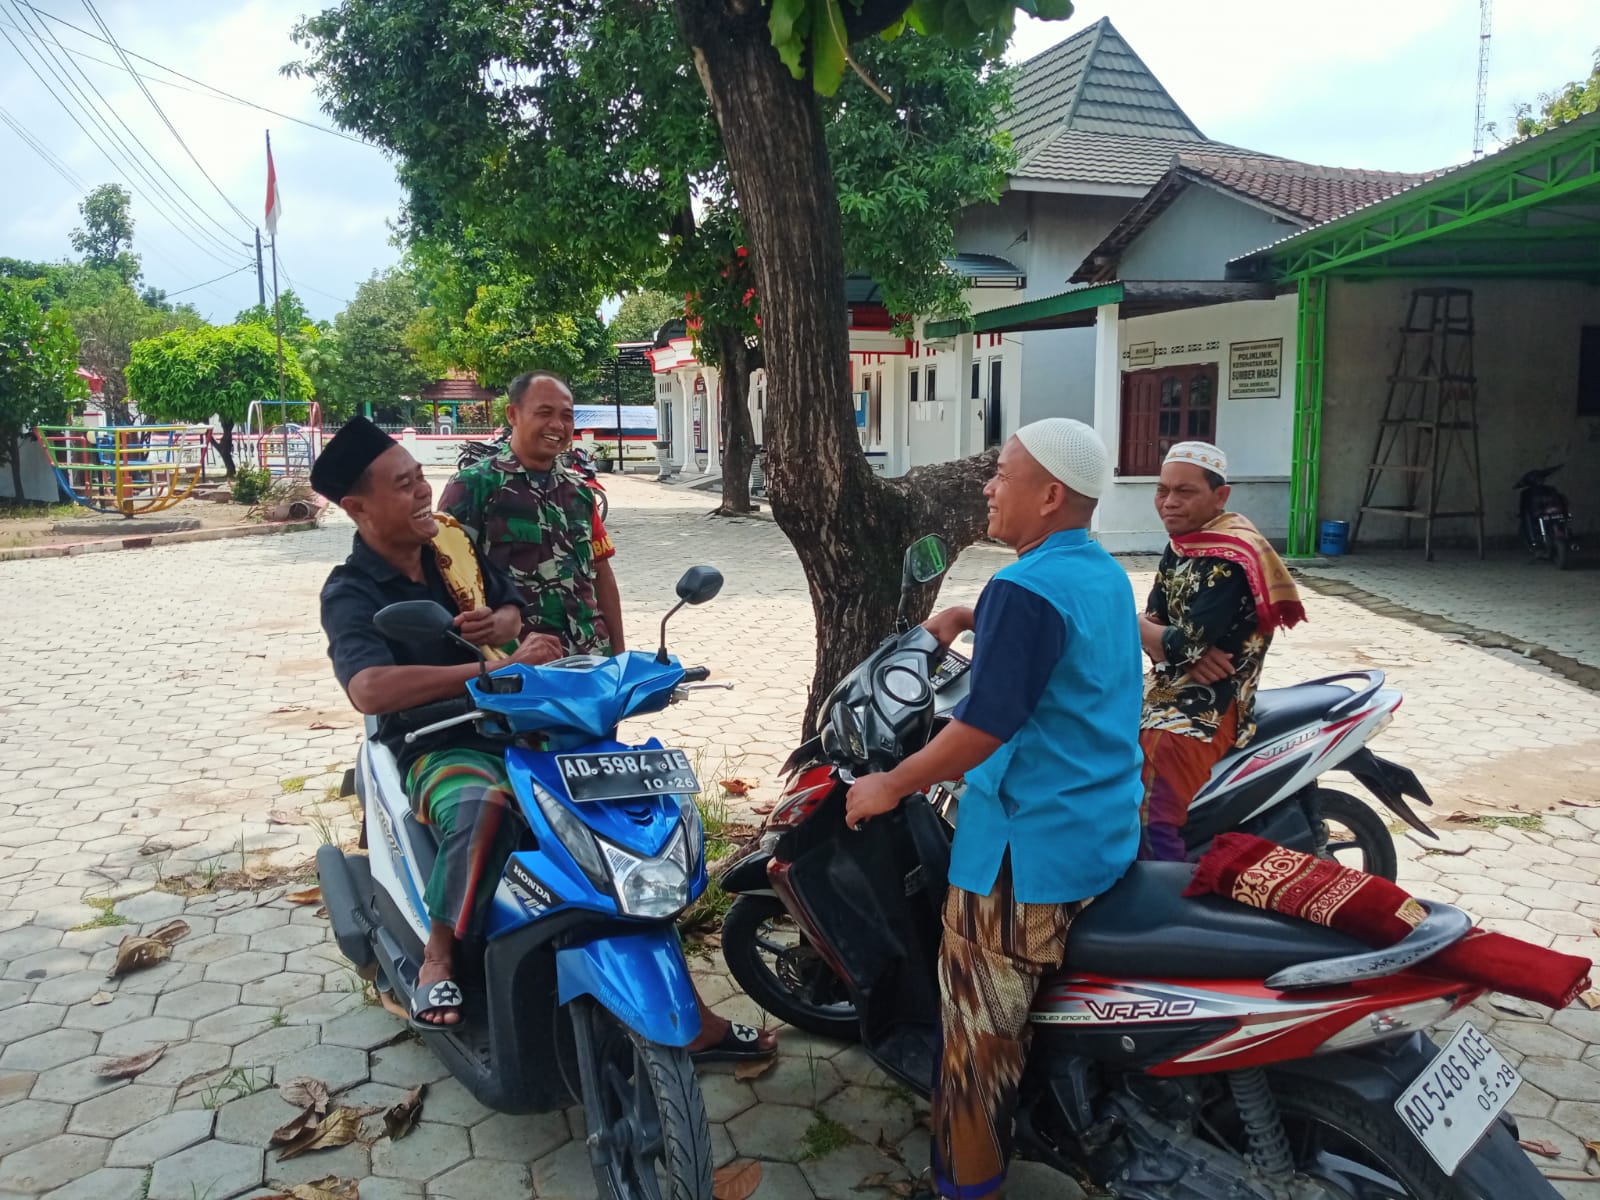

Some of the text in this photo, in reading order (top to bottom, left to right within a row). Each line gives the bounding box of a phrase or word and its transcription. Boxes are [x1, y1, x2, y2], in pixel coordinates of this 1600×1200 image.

[1238, 351, 1272, 360] POLIKLINIK
[1232, 369, 1256, 380] SUMBER
[564, 758, 591, 778] AD
[598, 755, 652, 774] 5984
[513, 865, 552, 904] HONDA
[1085, 998, 1198, 1020] VARIO
[1404, 1028, 1492, 1137] AD 5486 AGE
